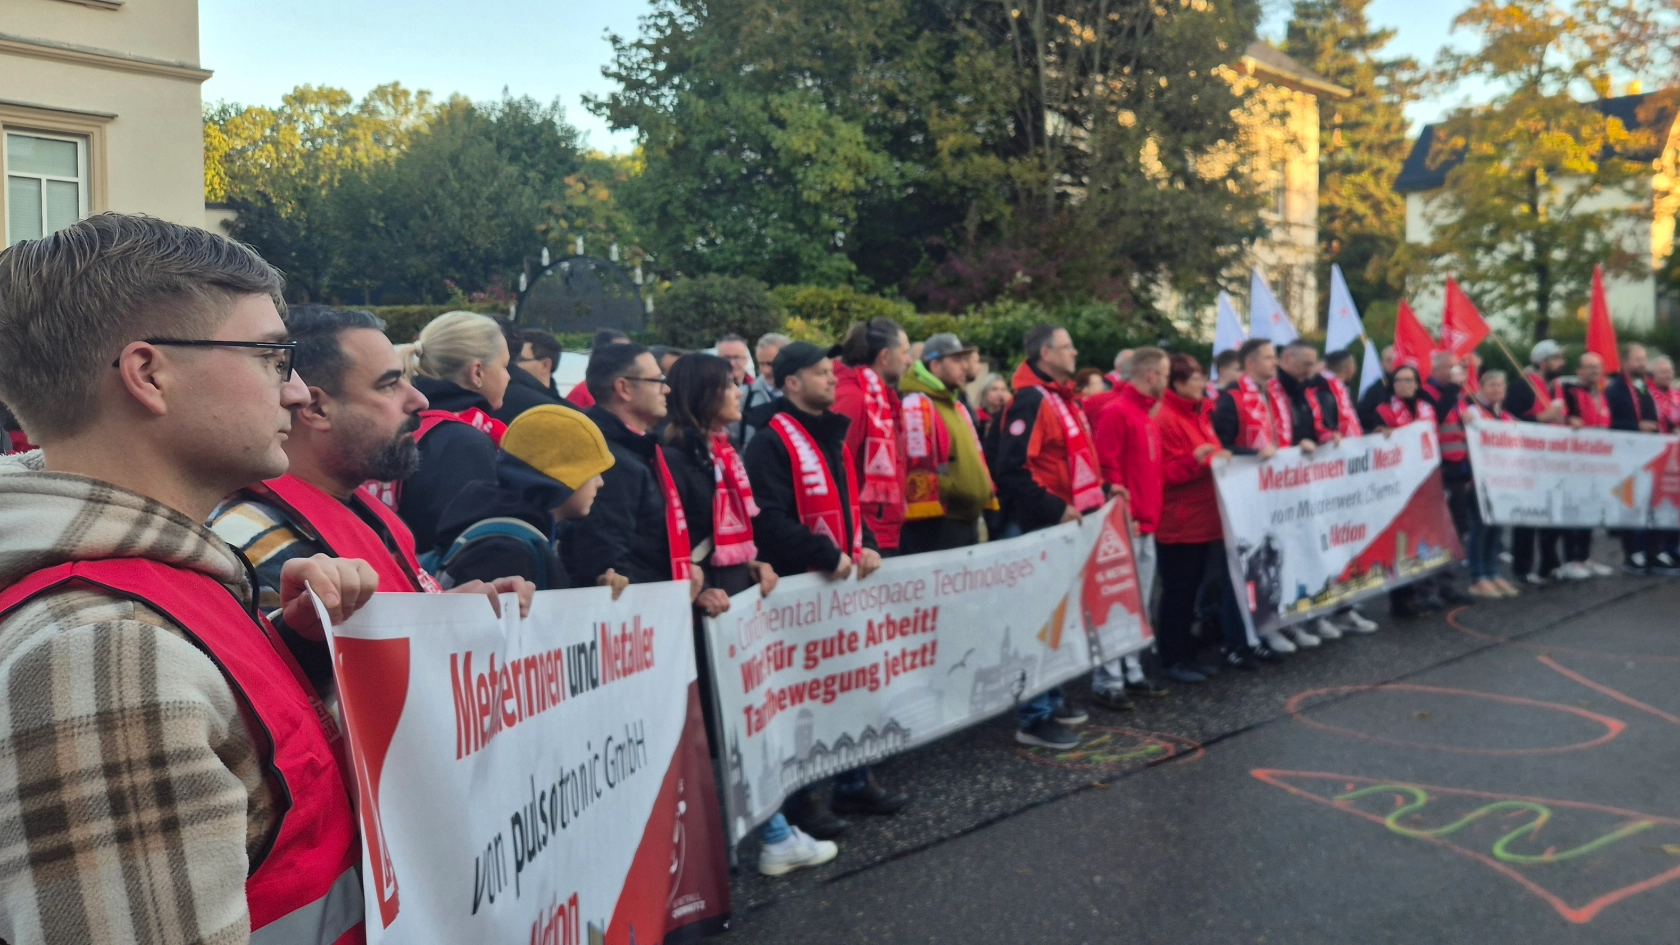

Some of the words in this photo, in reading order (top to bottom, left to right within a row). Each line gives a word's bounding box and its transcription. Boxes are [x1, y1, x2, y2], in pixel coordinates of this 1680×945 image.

[1348, 450, 1369, 476] und
[829, 578, 927, 622] Aerospace
[567, 622, 600, 698] und
[803, 629, 859, 671] gute
[865, 606, 939, 648] Arbeit!
[884, 640, 938, 686] jetzt!
[471, 831, 507, 916] von
[604, 718, 648, 790] GmbH
